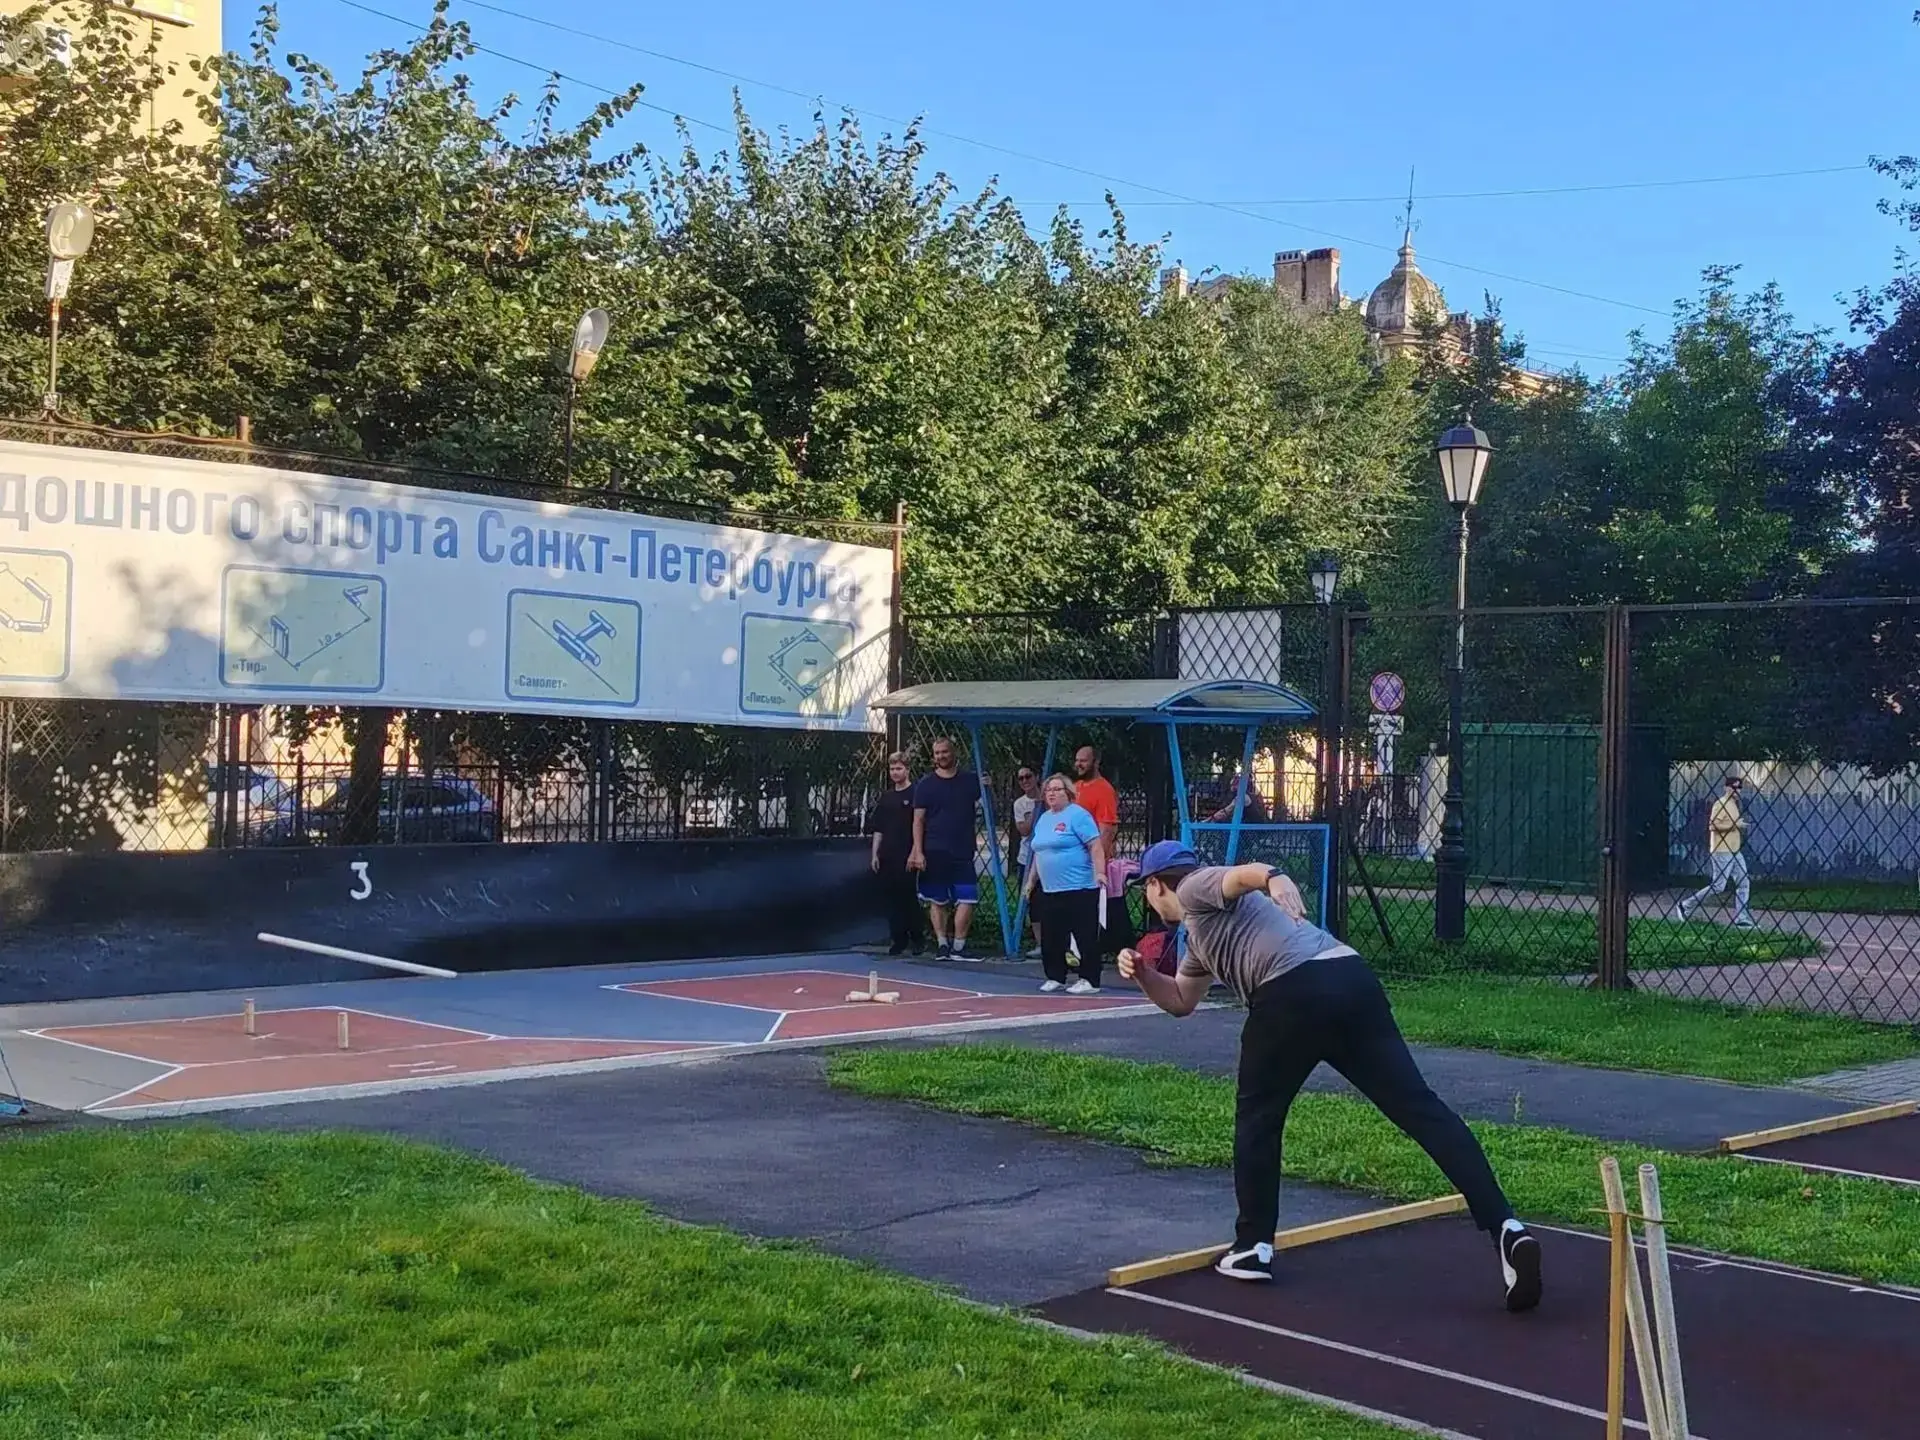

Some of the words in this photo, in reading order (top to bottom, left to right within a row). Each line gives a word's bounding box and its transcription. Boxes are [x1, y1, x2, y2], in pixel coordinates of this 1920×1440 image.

[0, 472, 260, 541] дошного
[282, 500, 459, 565] спорта
[477, 509, 857, 607] Санкт-Петербурга
[350, 861, 372, 900] 3
